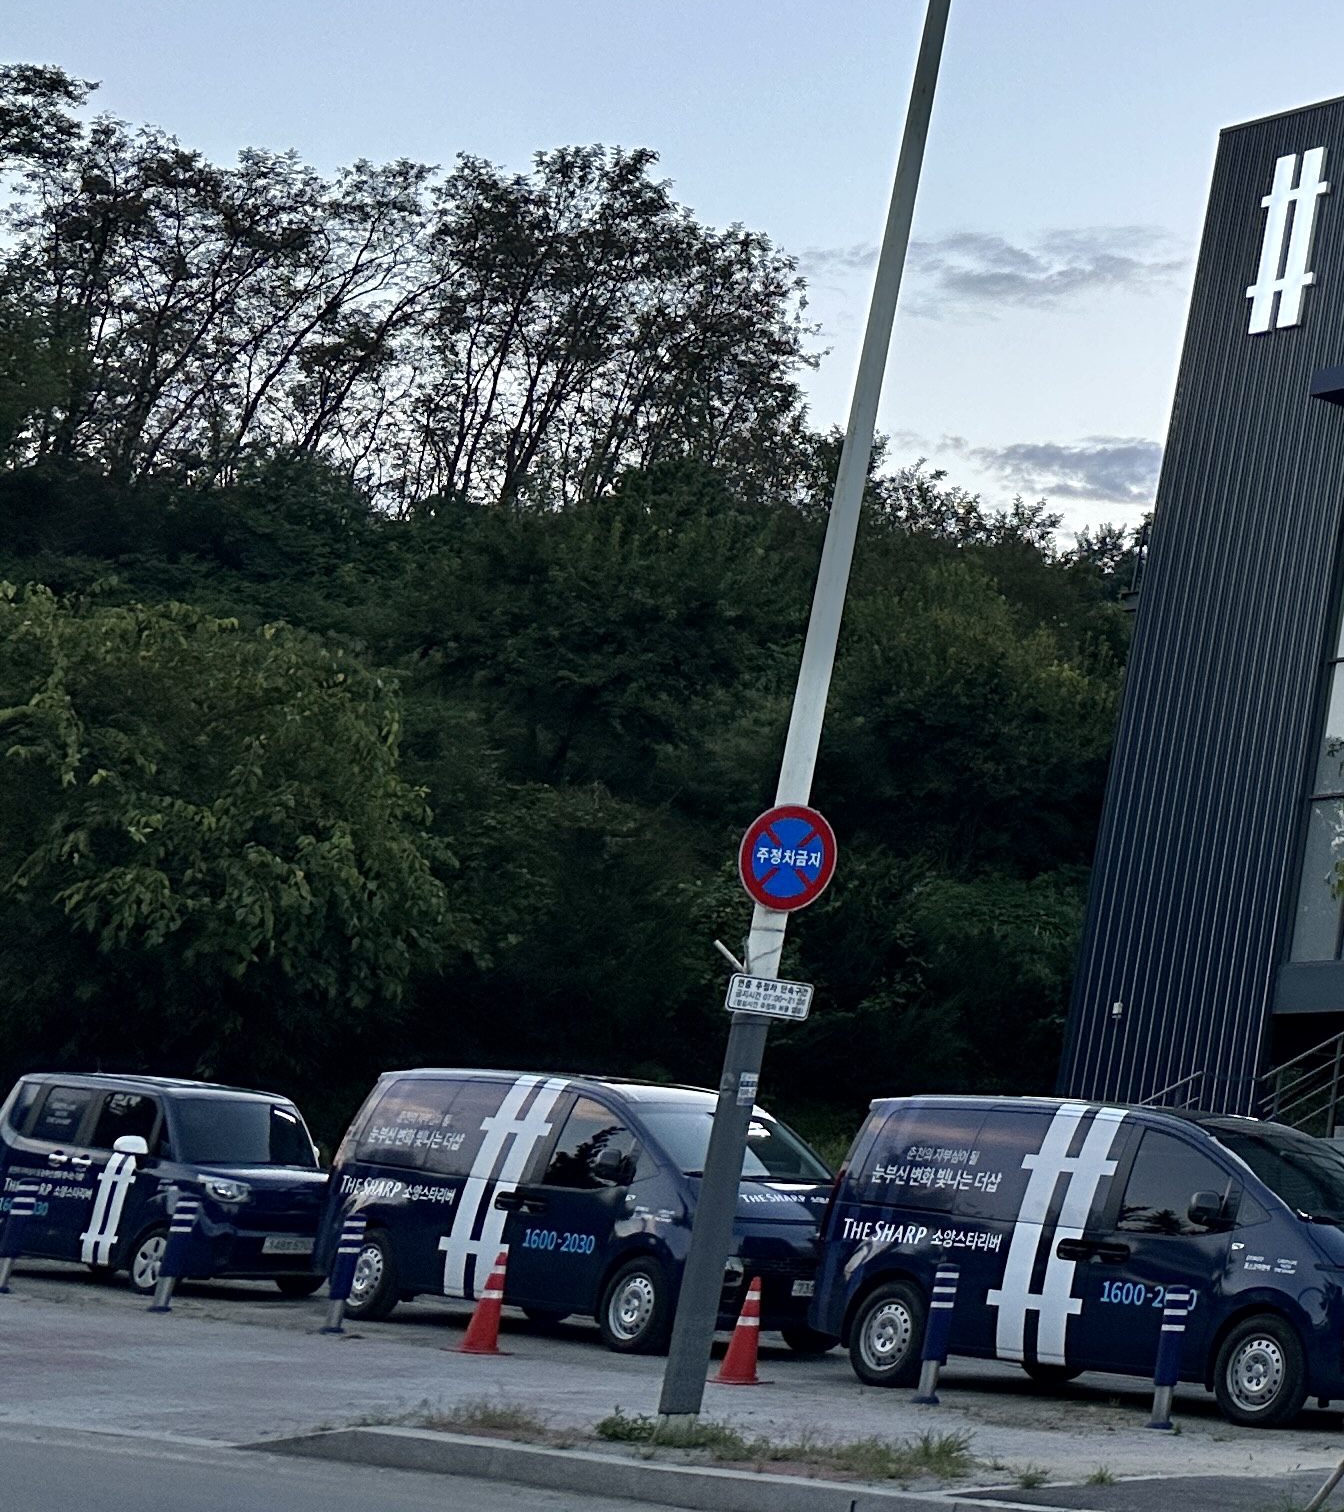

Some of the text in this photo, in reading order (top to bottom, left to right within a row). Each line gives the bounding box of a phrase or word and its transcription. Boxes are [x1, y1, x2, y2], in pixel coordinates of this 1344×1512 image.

[756, 847, 821, 868] 주정차금지
[367, 1126, 399, 1145] 눈부신
[443, 1132, 466, 1150] 더샵
[906, 1146, 934, 1162] 춘천의
[933, 1148, 970, 1165] 자부심이
[340, 1175, 456, 1205] THE SHARP 소양스타리버
[871, 1164, 1002, 1193] 눈부신 변화 빛나는 더샵
[522, 1229, 595, 1254] 1600-2030
[842, 1218, 1003, 1253] THE SHARP 소양스타리버
